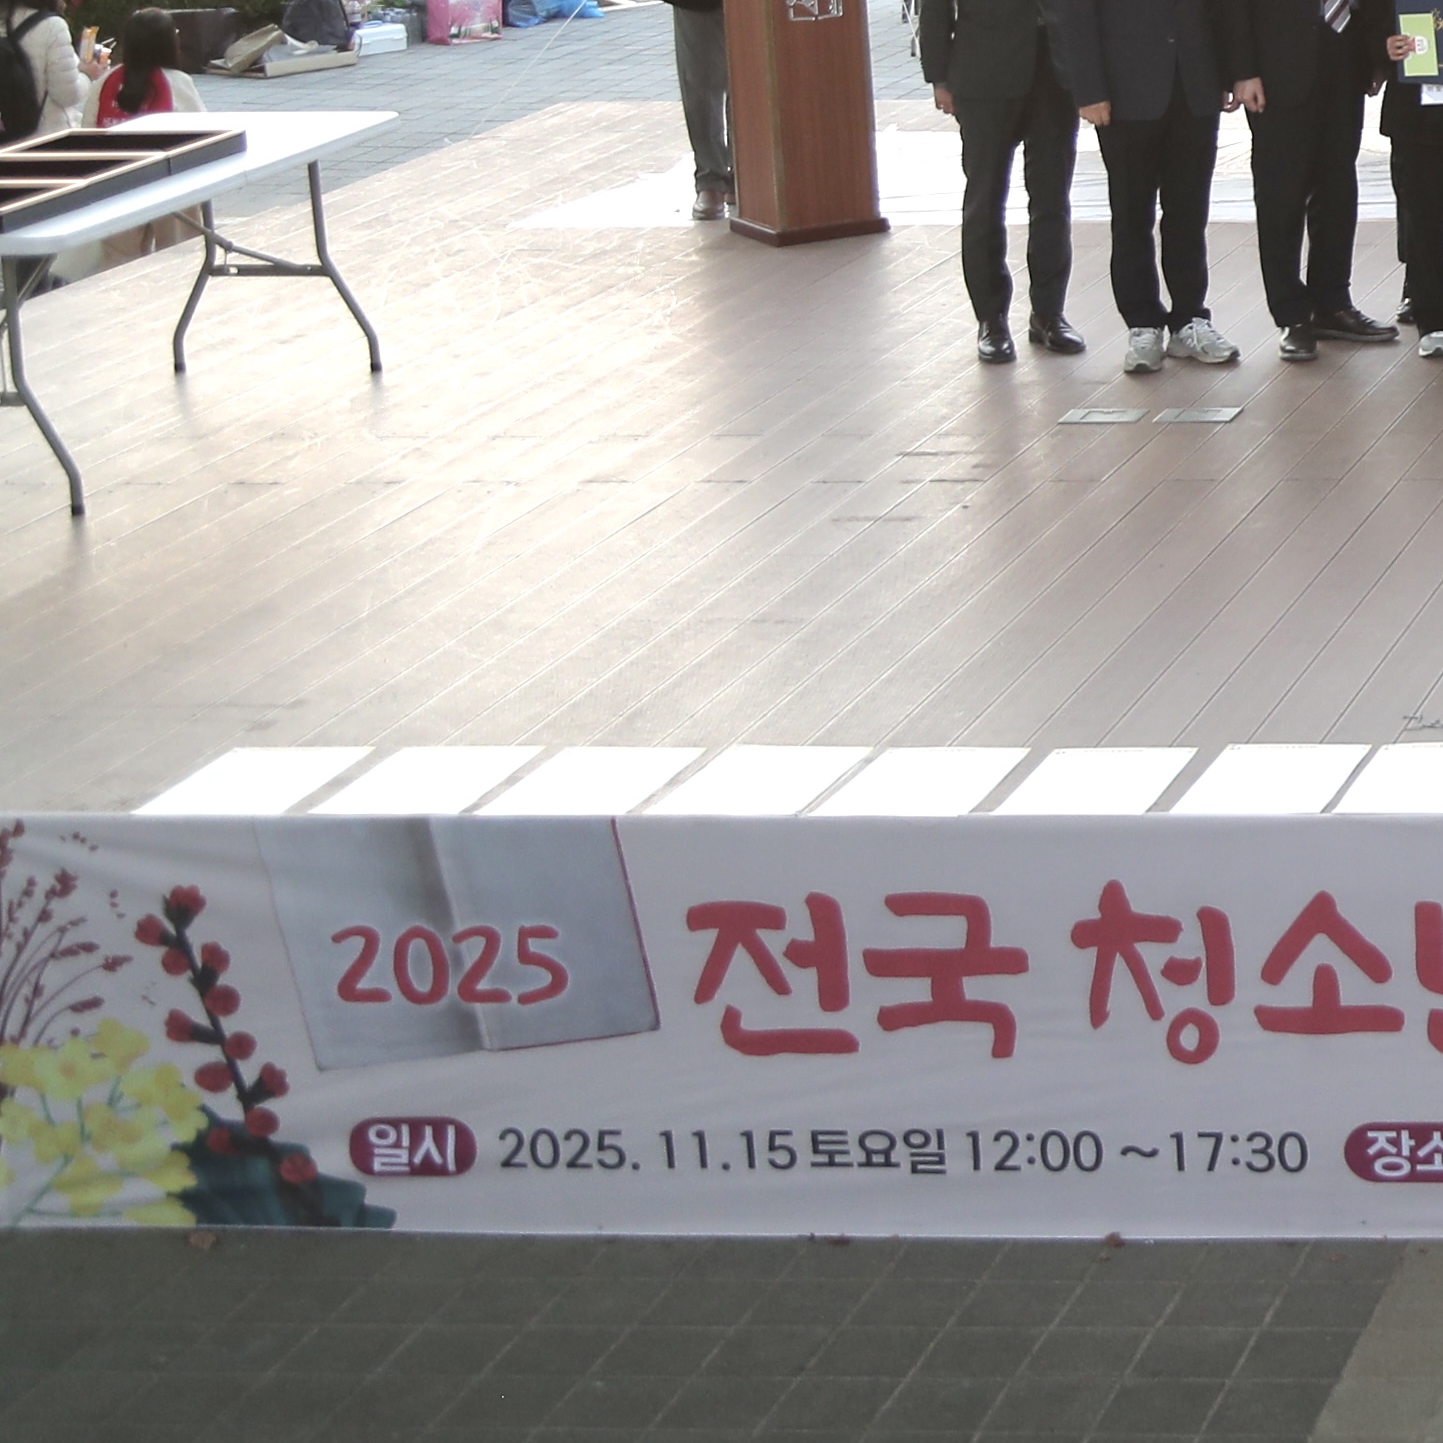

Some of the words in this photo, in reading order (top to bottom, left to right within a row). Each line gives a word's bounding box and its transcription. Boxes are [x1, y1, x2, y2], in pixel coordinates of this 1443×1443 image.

[331, 924, 570, 1007] 2025
[685, 891, 1030, 1060] 전국
[367, 1123, 457, 1175] 일시
[809, 1128, 947, 1176] 토요일
